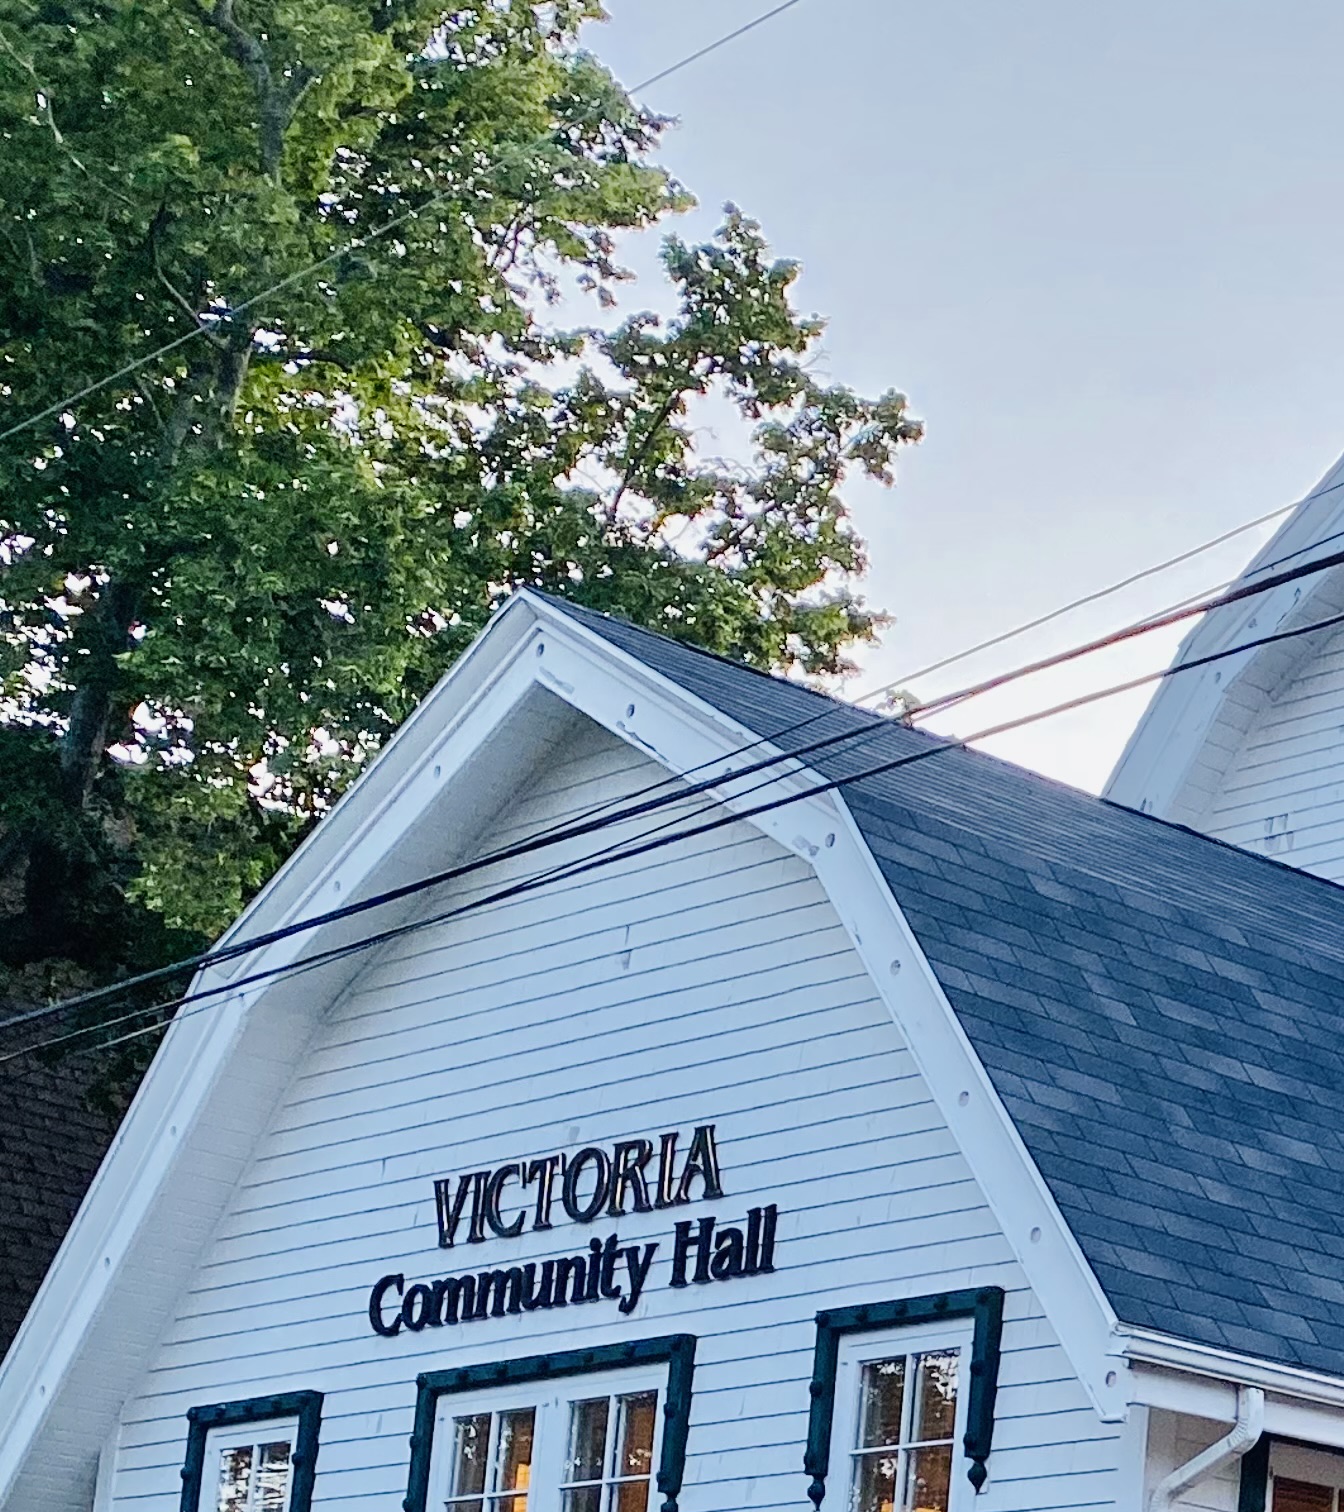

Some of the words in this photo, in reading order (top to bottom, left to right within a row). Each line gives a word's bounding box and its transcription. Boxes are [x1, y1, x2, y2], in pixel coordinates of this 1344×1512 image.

[433, 1124, 723, 1248] VICTORIA
[369, 1234, 659, 1337] Community
[669, 1204, 778, 1288] Hall
